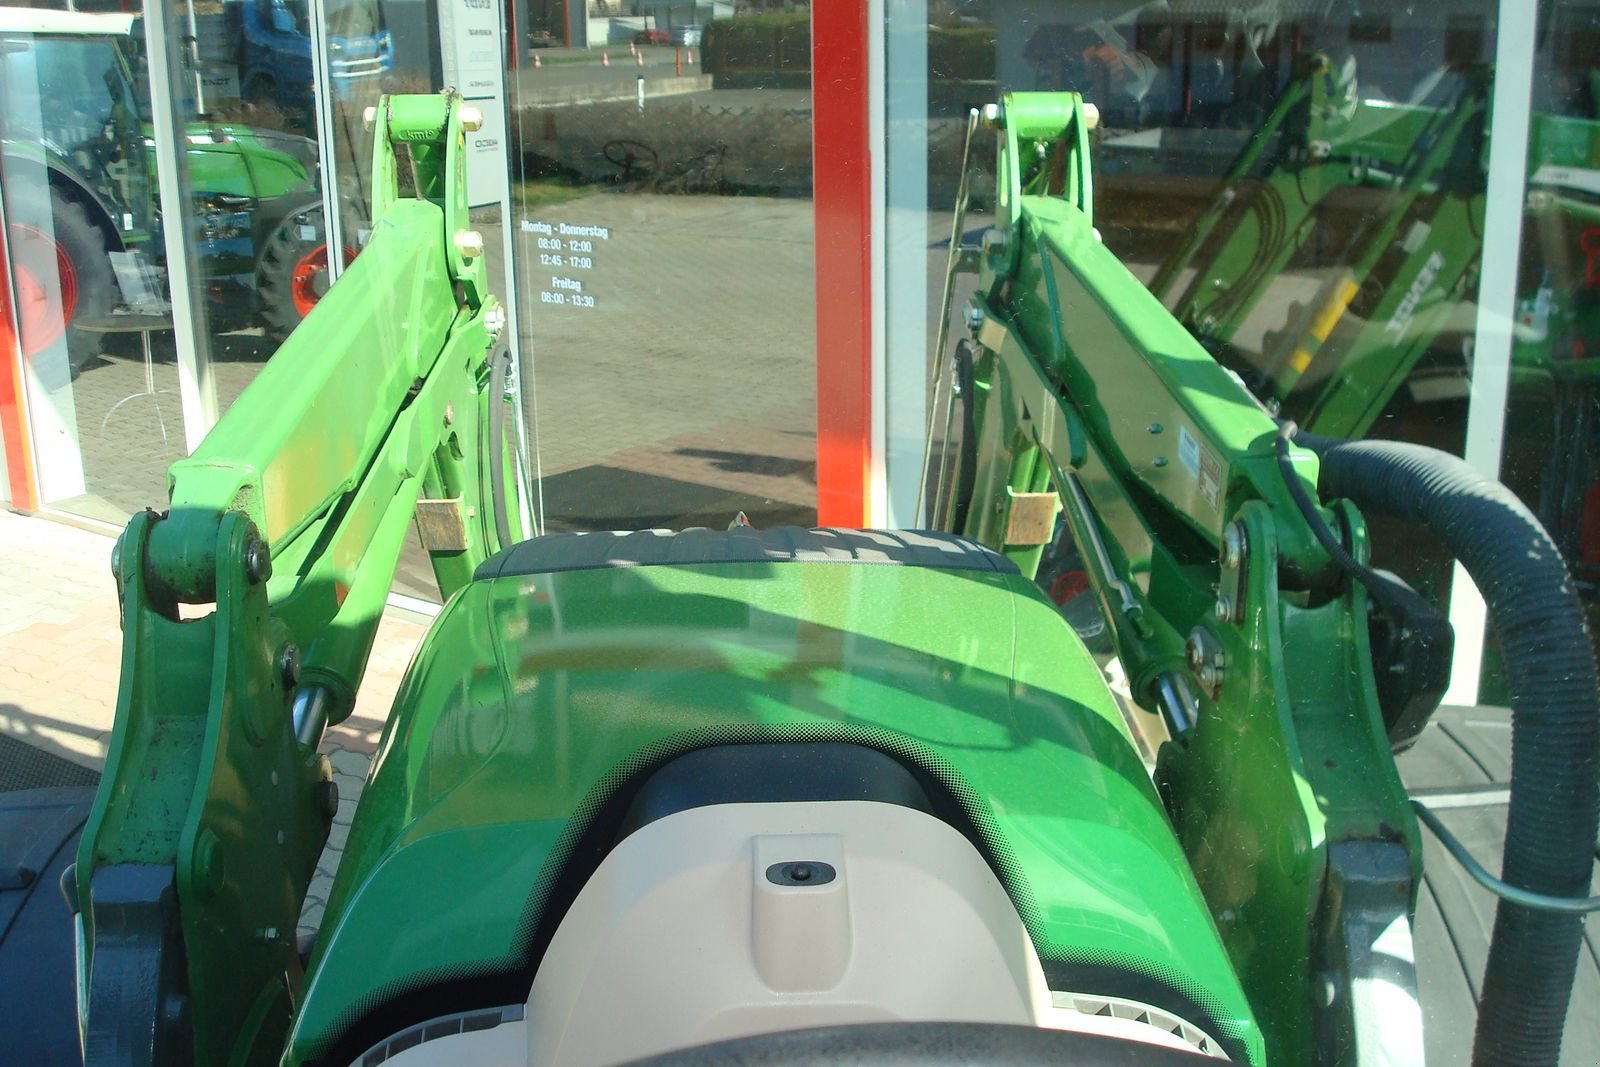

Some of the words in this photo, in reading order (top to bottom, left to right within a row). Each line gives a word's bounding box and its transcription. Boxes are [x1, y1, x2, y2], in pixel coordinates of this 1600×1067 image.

[521, 220, 552, 235] Montag
[560, 223, 608, 239] Donnerstag
[538, 238, 561, 249] 08:00
[569, 240, 592, 252] 12:00
[540, 254, 562, 266] 12:45
[569, 257, 592, 269] 17:00
[552, 277, 581, 292] Freitag
[541, 292, 564, 304] 08:00
[571, 295, 594, 307] 13:30
